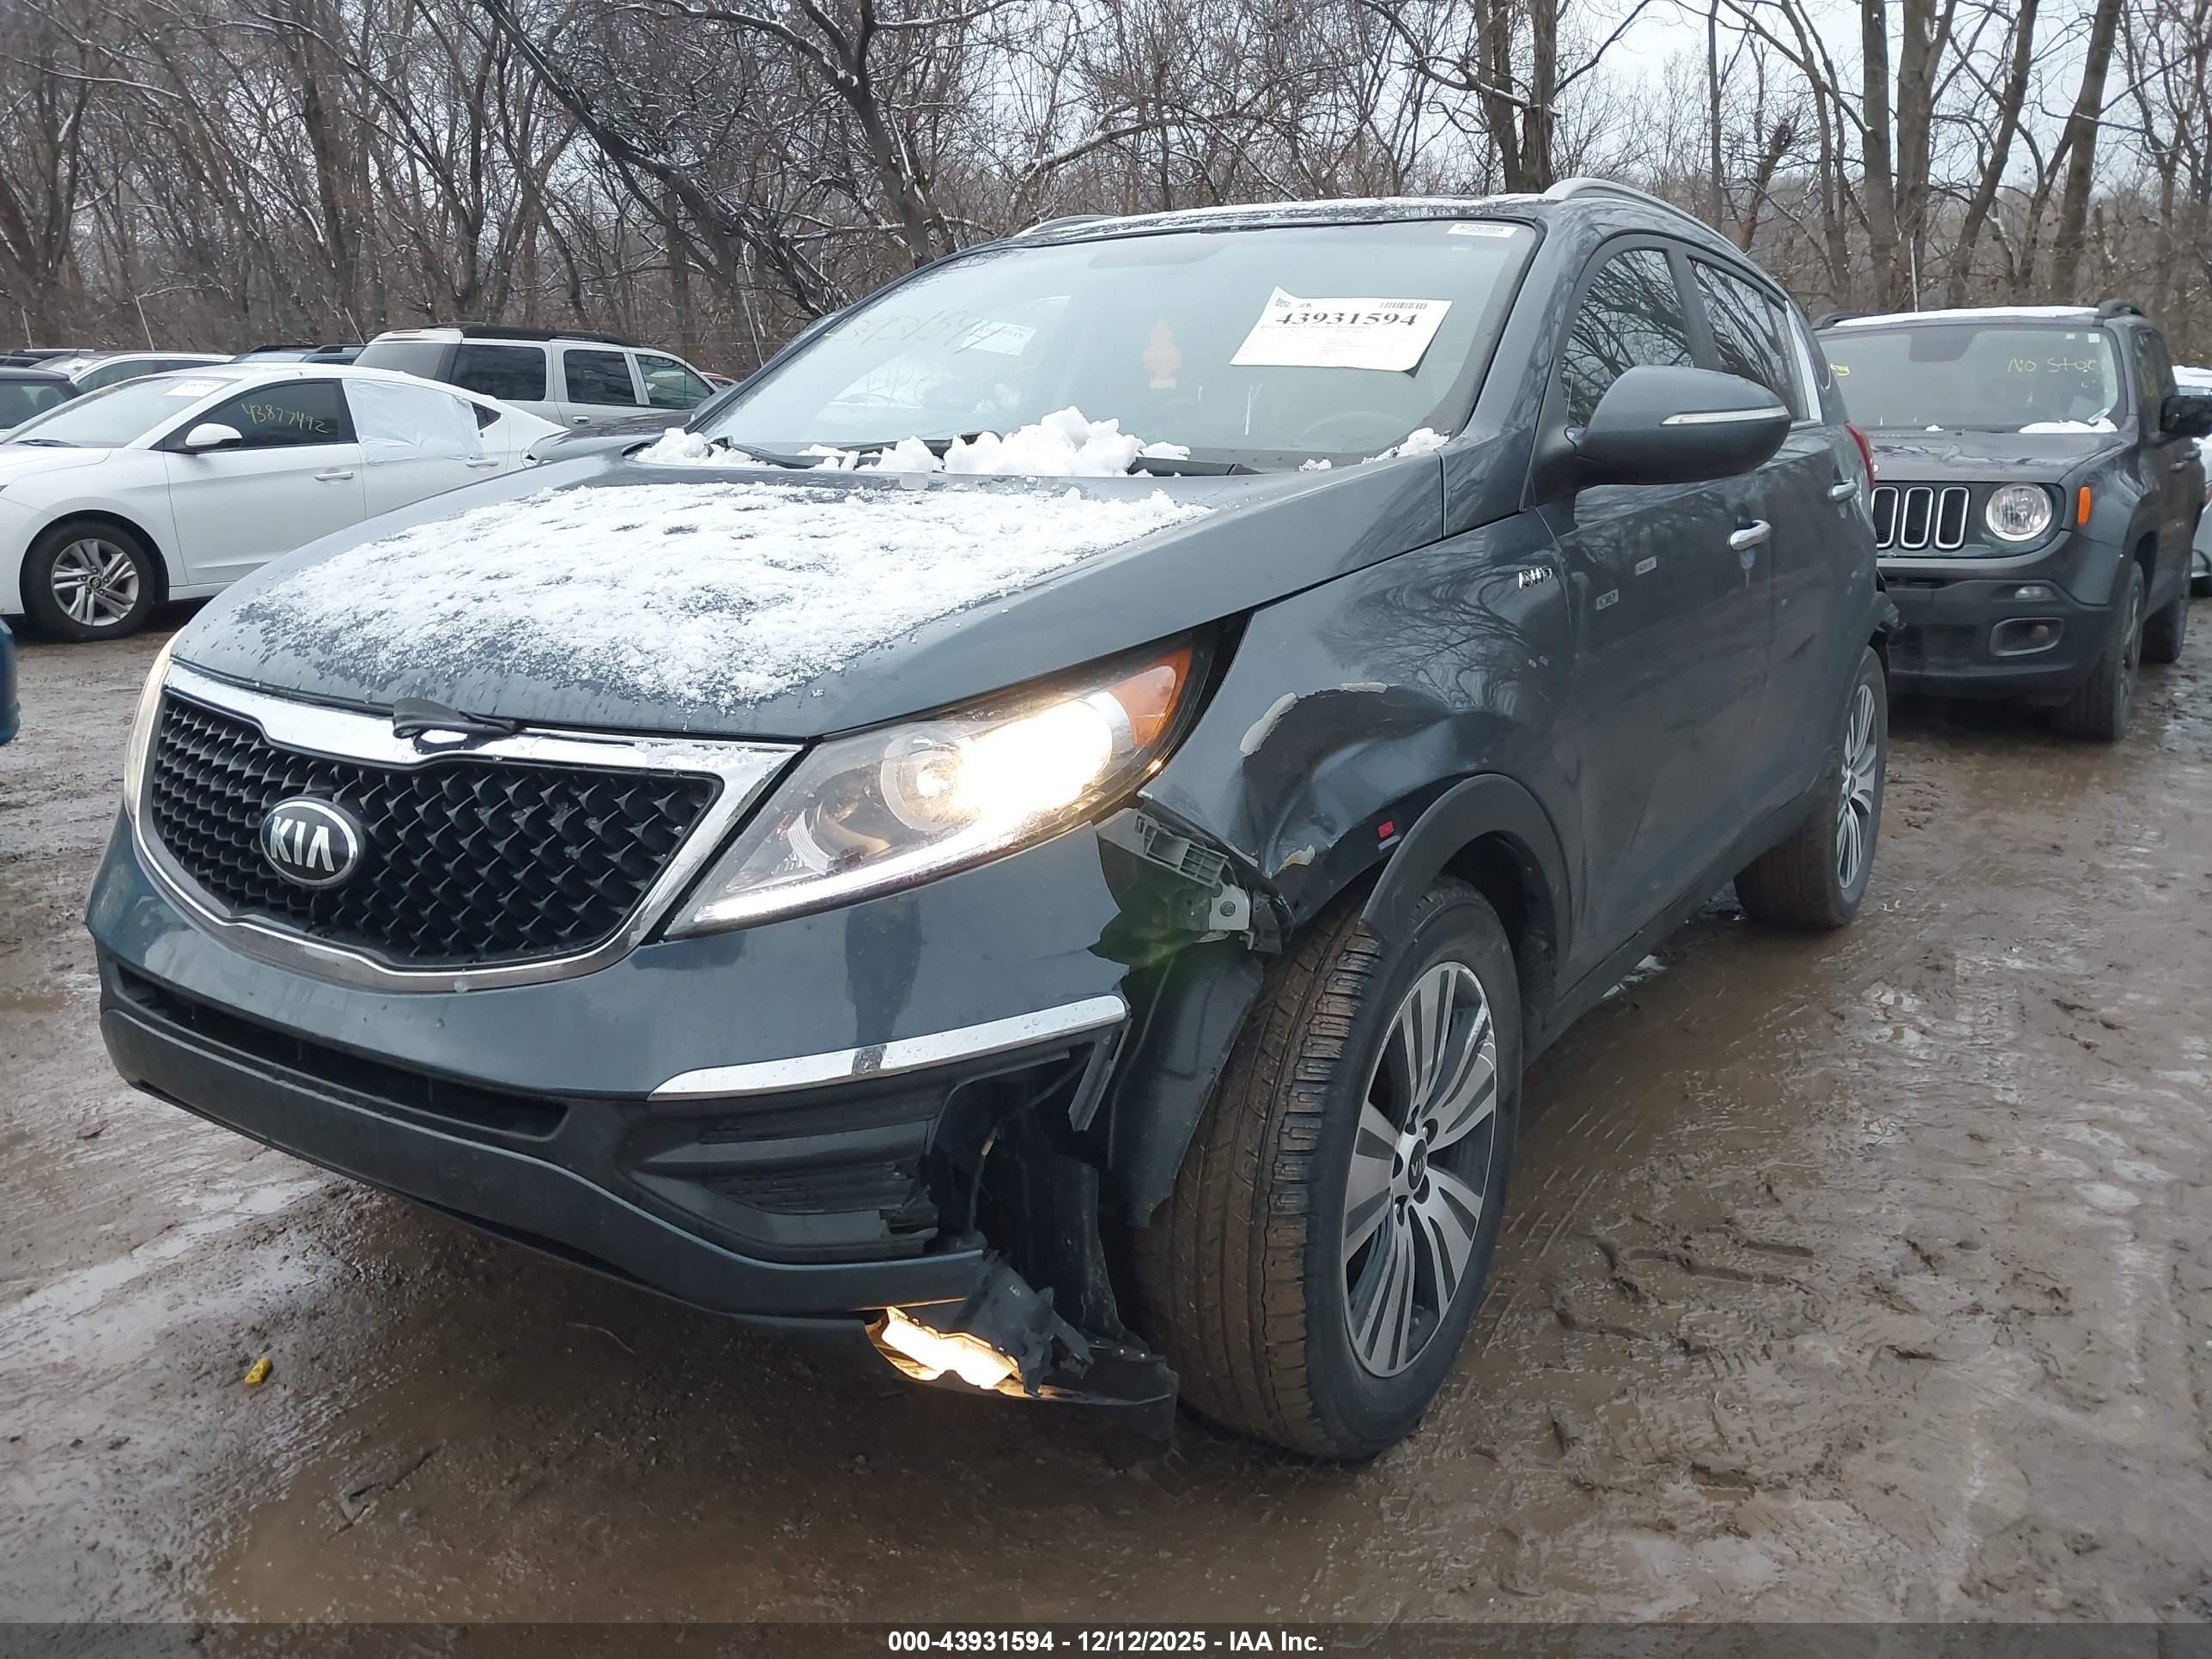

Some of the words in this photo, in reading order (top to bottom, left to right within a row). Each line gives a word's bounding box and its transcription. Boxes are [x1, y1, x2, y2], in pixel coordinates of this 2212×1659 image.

[1275, 312, 1418, 326] 43931594
[240, 402, 330, 434] 43877492
[270, 816, 335, 872] KIA
